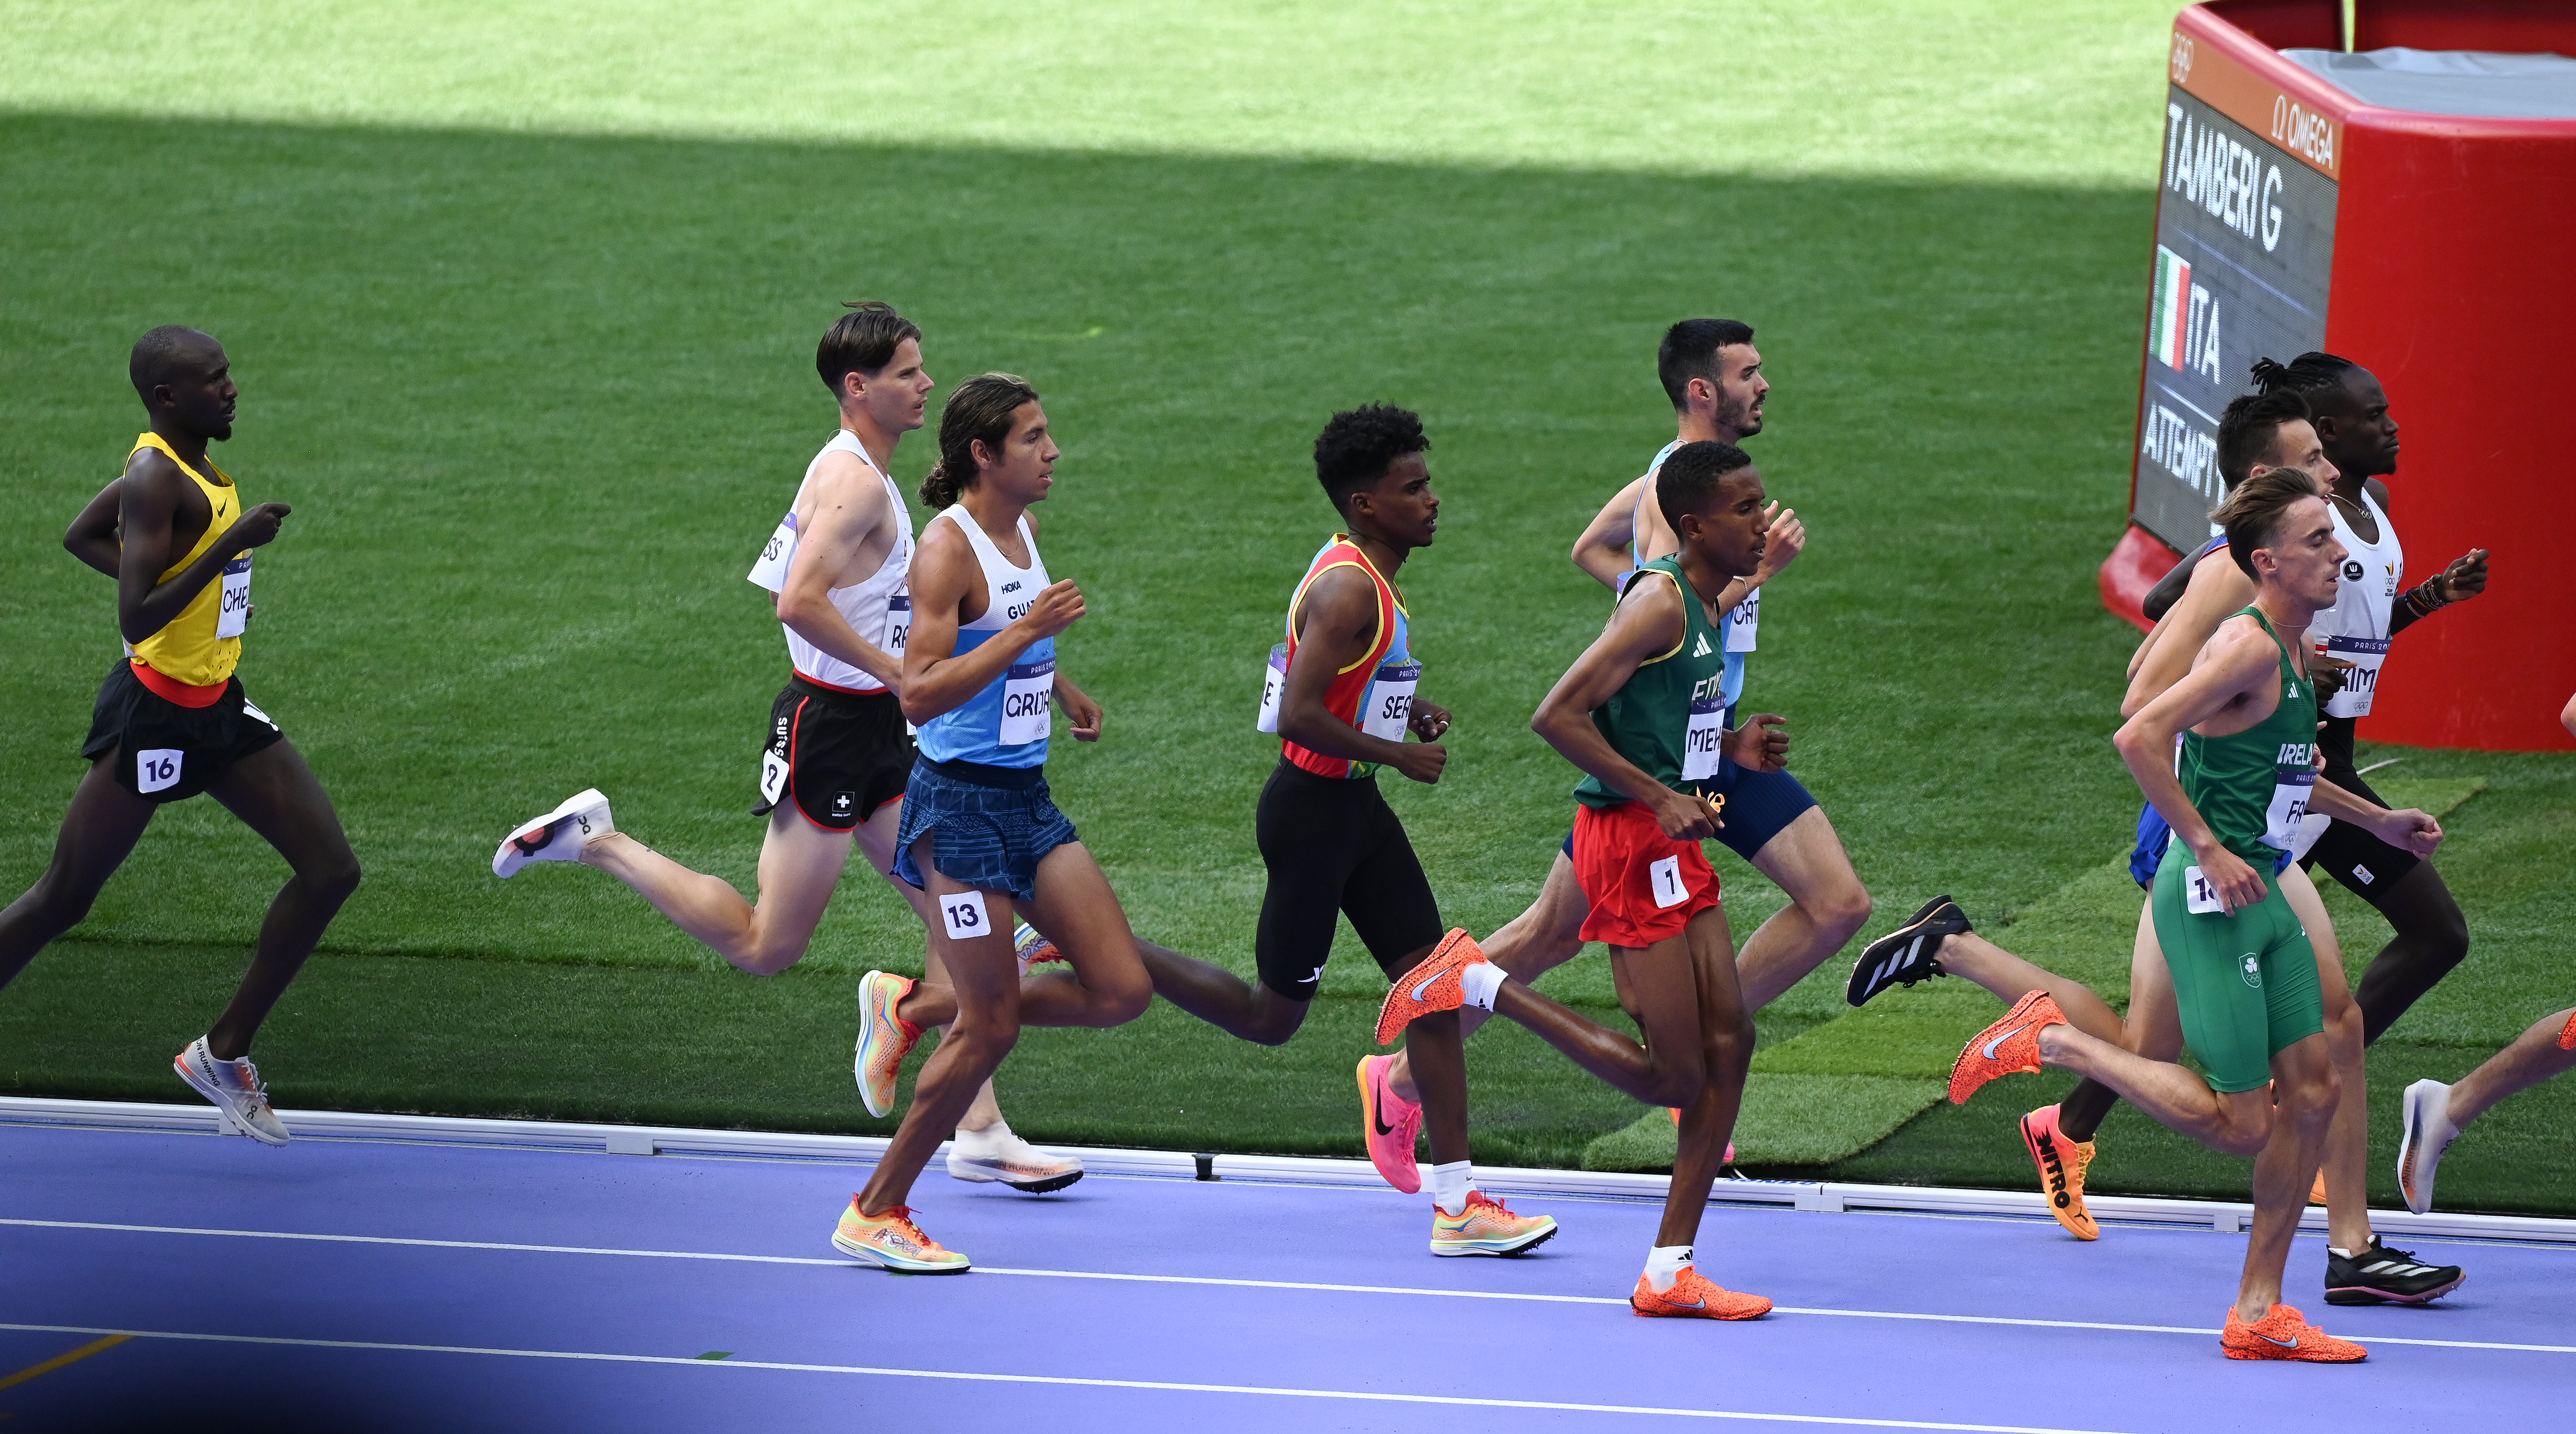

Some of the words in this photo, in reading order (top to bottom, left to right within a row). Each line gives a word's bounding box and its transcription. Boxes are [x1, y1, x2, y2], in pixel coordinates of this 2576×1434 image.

[2288, 103, 2333, 169] OMEGA
[2167, 103, 2261, 239] TAMBERI
[2262, 164, 2283, 252] G
[2185, 282, 2220, 384] ITA
[2142, 400, 2217, 497] ATTEMPT
[223, 584, 249, 613] CHE
[1001, 581, 1022, 595] HOKA
[2355, 641, 2376, 650] PARIS
[1031, 664, 1045, 674] PARIS
[1399, 670, 1413, 678] PARIS
[1383, 695, 1412, 719] SEA
[146, 757, 175, 782] 16
[767, 764, 778, 793] 2
[1665, 866, 1675, 895] 1
[2194, 877, 2214, 902] 1
[948, 904, 979, 928] 13
[196, 1039, 203, 1051] ON
[199, 1051, 220, 1087] RUNNING
[2032, 1125, 2071, 1209] NITRO
